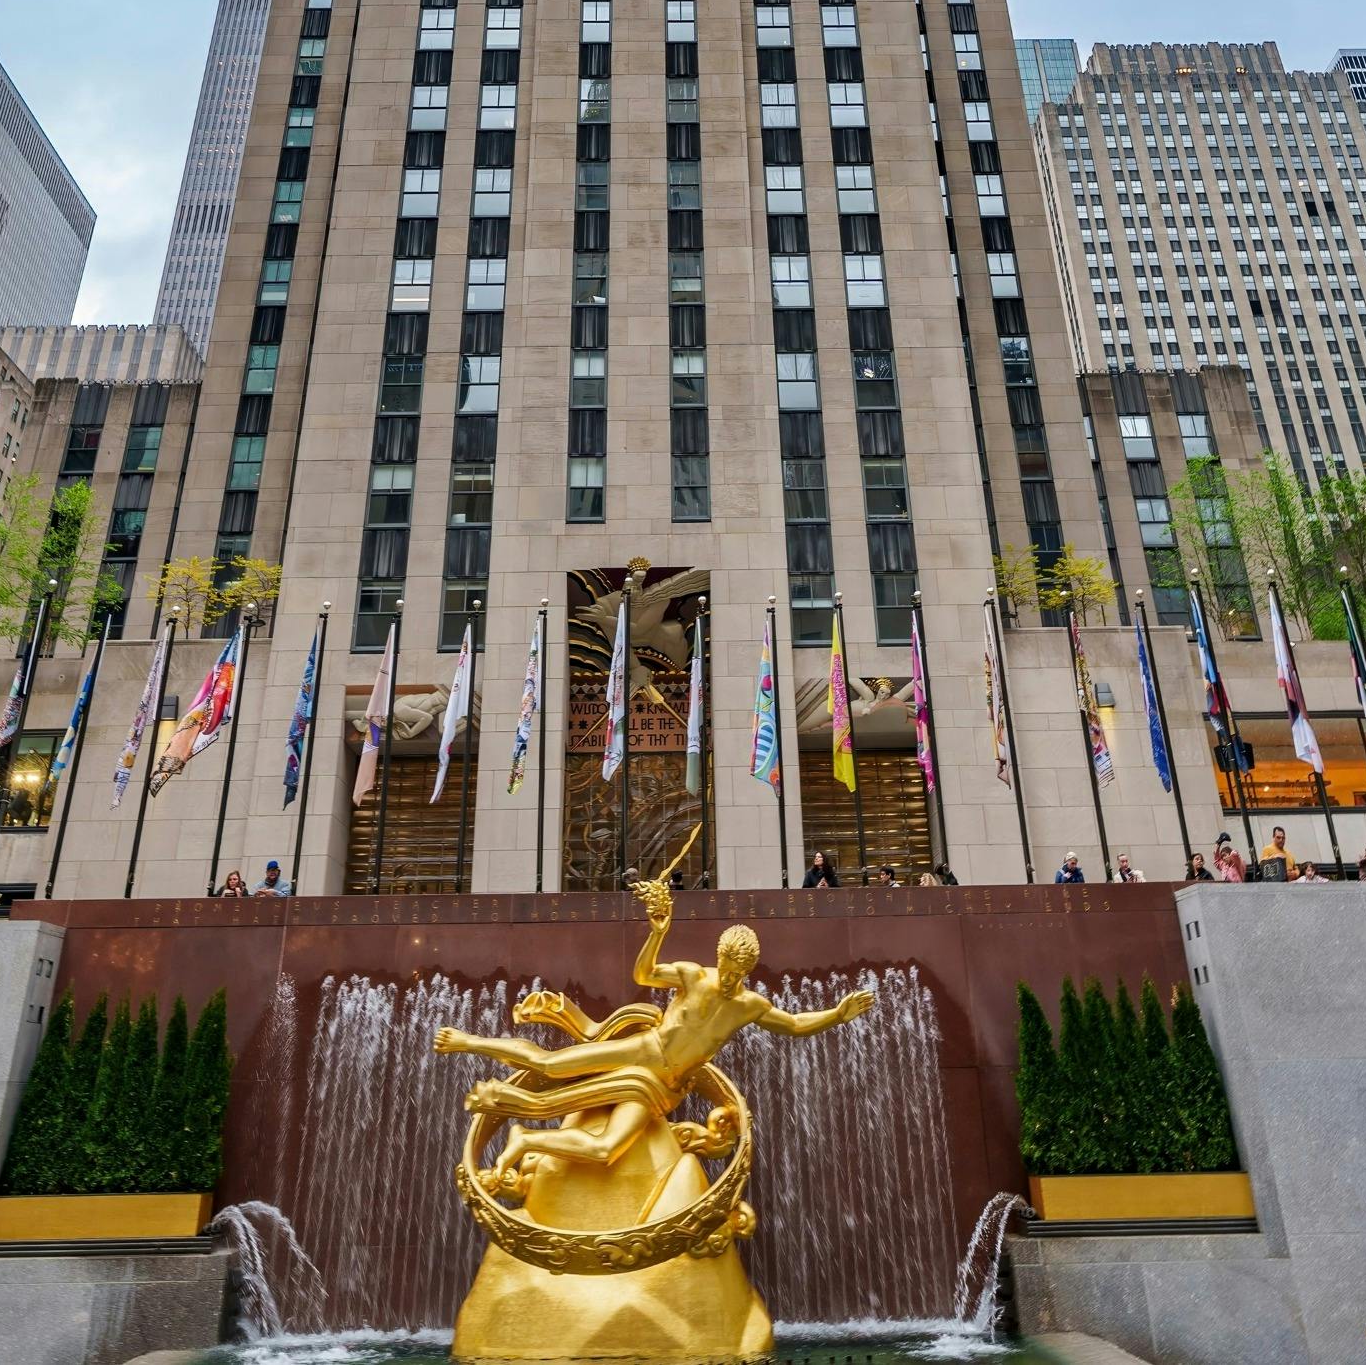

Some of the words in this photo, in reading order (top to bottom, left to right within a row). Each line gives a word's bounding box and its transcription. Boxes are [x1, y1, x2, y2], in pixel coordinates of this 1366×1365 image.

[570, 703, 609, 714] WISDO
[641, 718, 654, 730] BE
[657, 718, 675, 730] THE
[569, 734, 607, 747] STABIL
[628, 734, 644, 746] OF
[647, 734, 669, 746] THY
